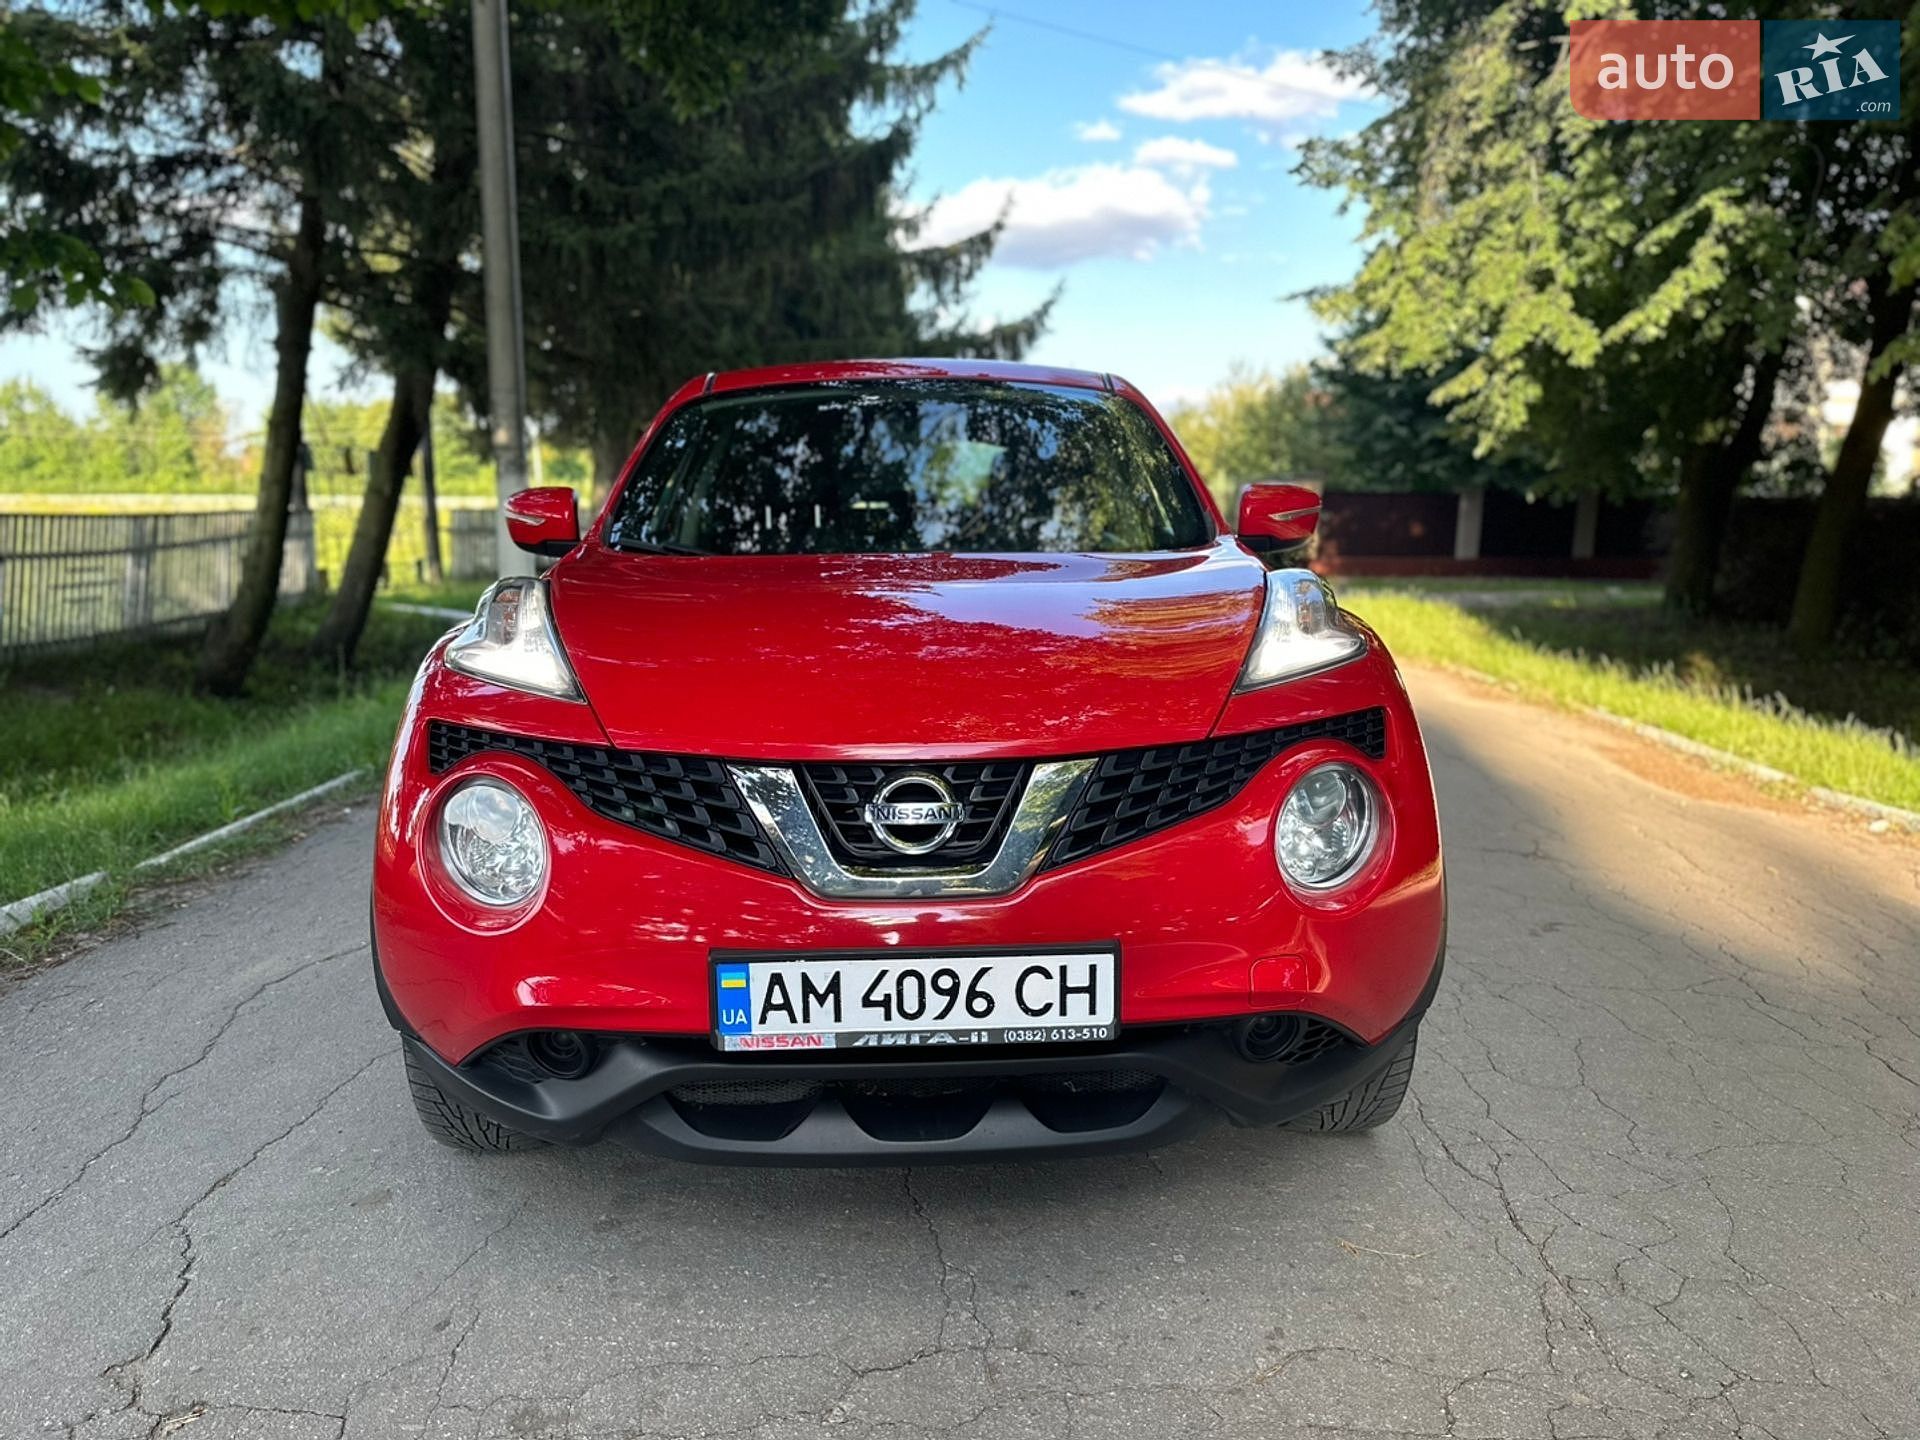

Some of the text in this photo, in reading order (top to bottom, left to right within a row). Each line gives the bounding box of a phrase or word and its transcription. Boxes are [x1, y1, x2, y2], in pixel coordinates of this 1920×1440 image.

[876, 806, 953, 821] NISSAN
[758, 964, 1098, 1025] AM 4096 CH
[722, 1009, 748, 1025] UA
[739, 1034, 823, 1048] NISSAN
[1003, 1027, 1108, 1043] (0382) 613-510
